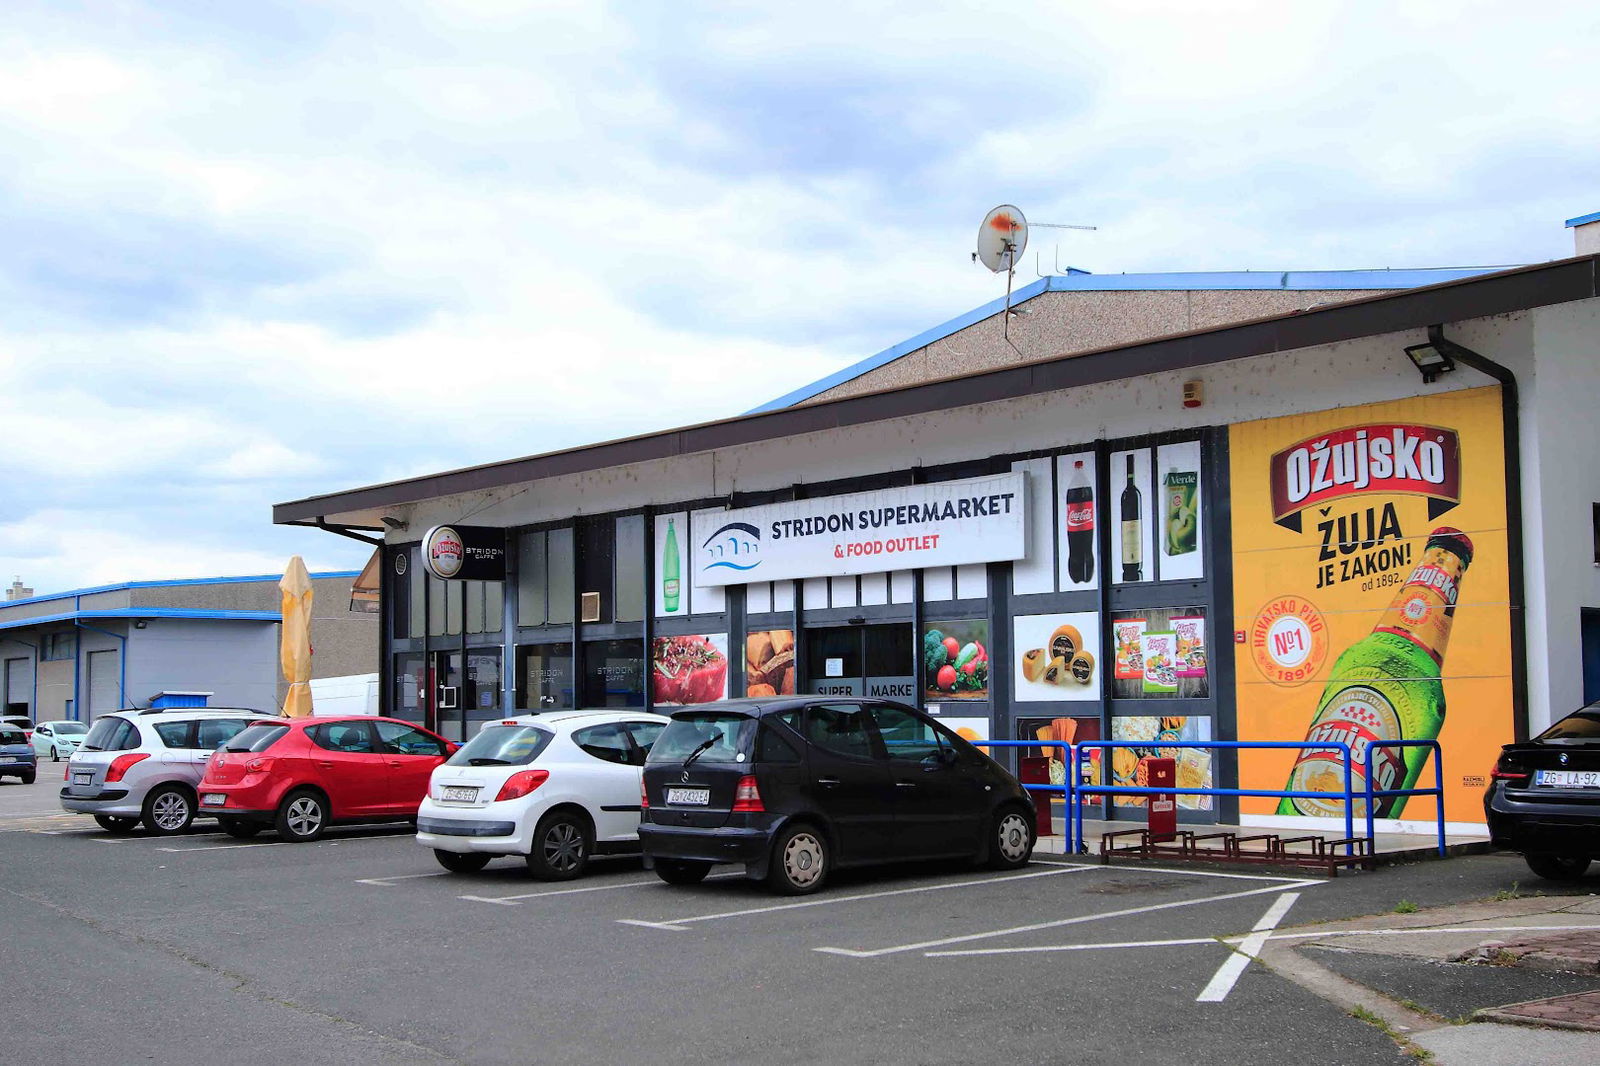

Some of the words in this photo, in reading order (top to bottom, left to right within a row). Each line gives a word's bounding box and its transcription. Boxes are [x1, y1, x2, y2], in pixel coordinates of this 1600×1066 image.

[1286, 428, 1444, 503] Ožujsko
[772, 512, 854, 539] STRIDON
[859, 493, 1014, 530] SUPERMARKET
[1317, 502, 1402, 562] ŽUJA
[465, 547, 504, 555] STRIDON
[834, 544, 844, 558] &
[847, 541, 882, 557] FOOD
[886, 534, 940, 553] OUTLET
[1316, 562, 1336, 589] JE
[1340, 542, 1412, 582] ZAKON!
[1361, 579, 1374, 592] od
[1376, 572, 1403, 589] 1892.
[1254, 599, 1296, 648] HRVATSKO
[597, 666, 633, 675] STRIDON
[1278, 662, 1315, 681] 1892
[870, 684, 914, 697] MARKE
[1544, 772, 1557, 784] ZG
